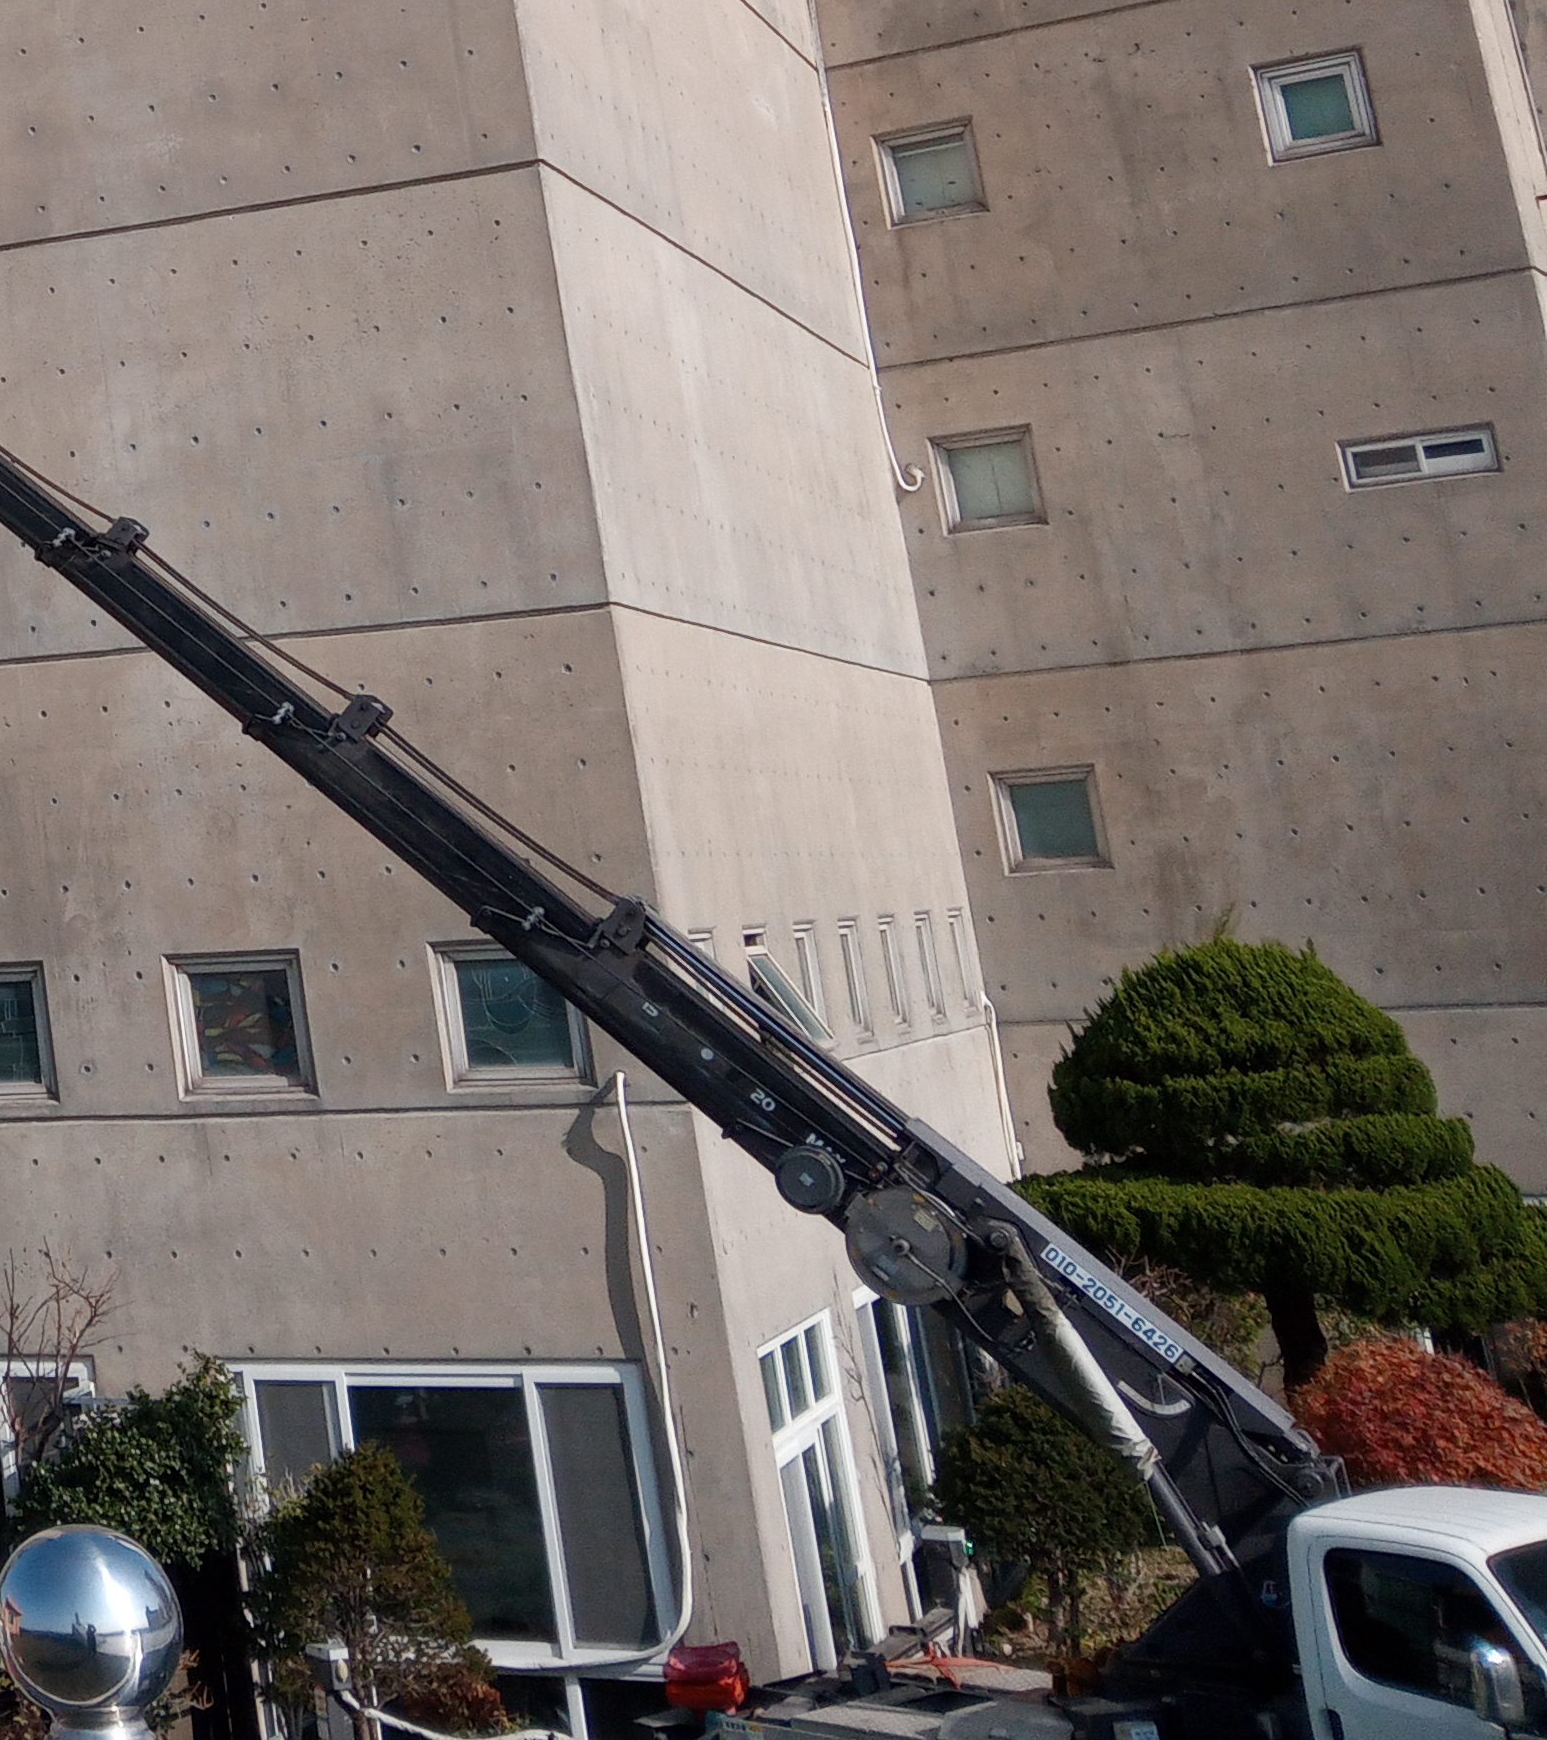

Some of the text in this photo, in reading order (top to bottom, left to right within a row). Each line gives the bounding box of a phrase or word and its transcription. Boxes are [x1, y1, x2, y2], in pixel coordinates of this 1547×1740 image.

[749, 1090, 776, 1111] 20
[805, 1132, 847, 1164] MX
[1044, 1247, 1179, 1359] 010-2051-6426
